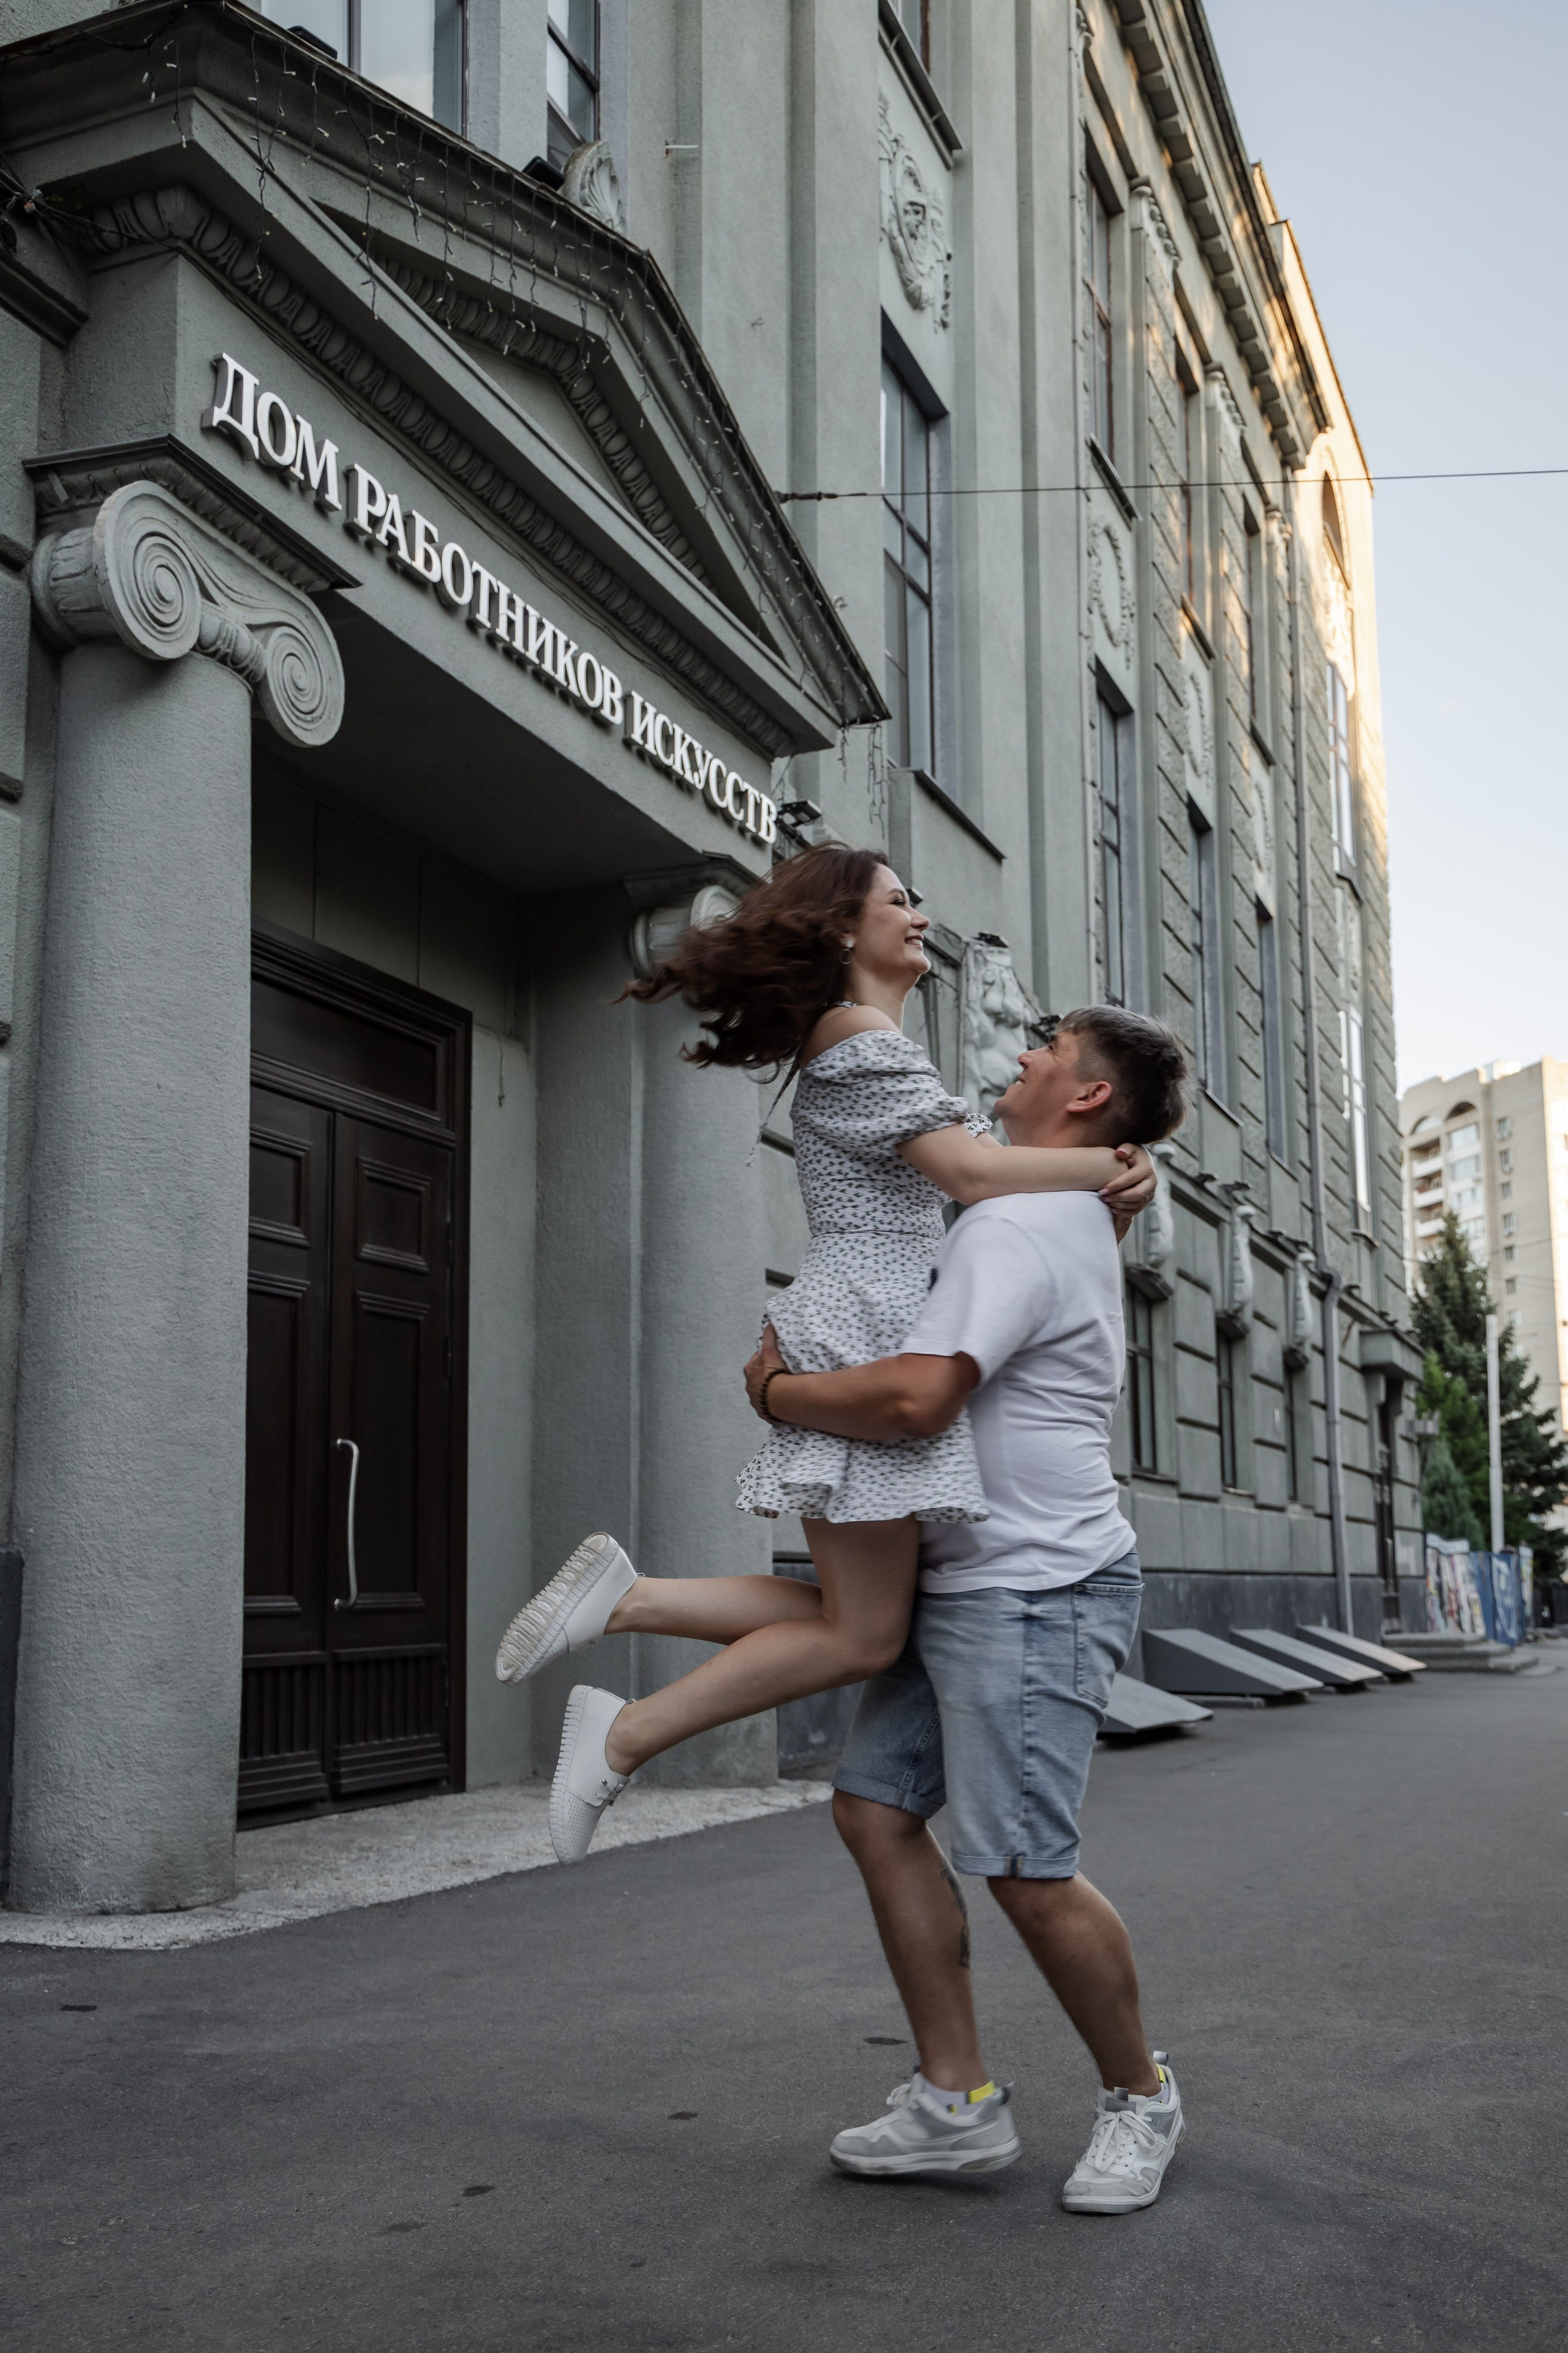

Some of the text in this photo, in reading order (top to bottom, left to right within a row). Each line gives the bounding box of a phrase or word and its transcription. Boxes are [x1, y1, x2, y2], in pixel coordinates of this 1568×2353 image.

[211, 352, 778, 845] ДОМ РАБОТНИКОВ ИСКУССТВ
